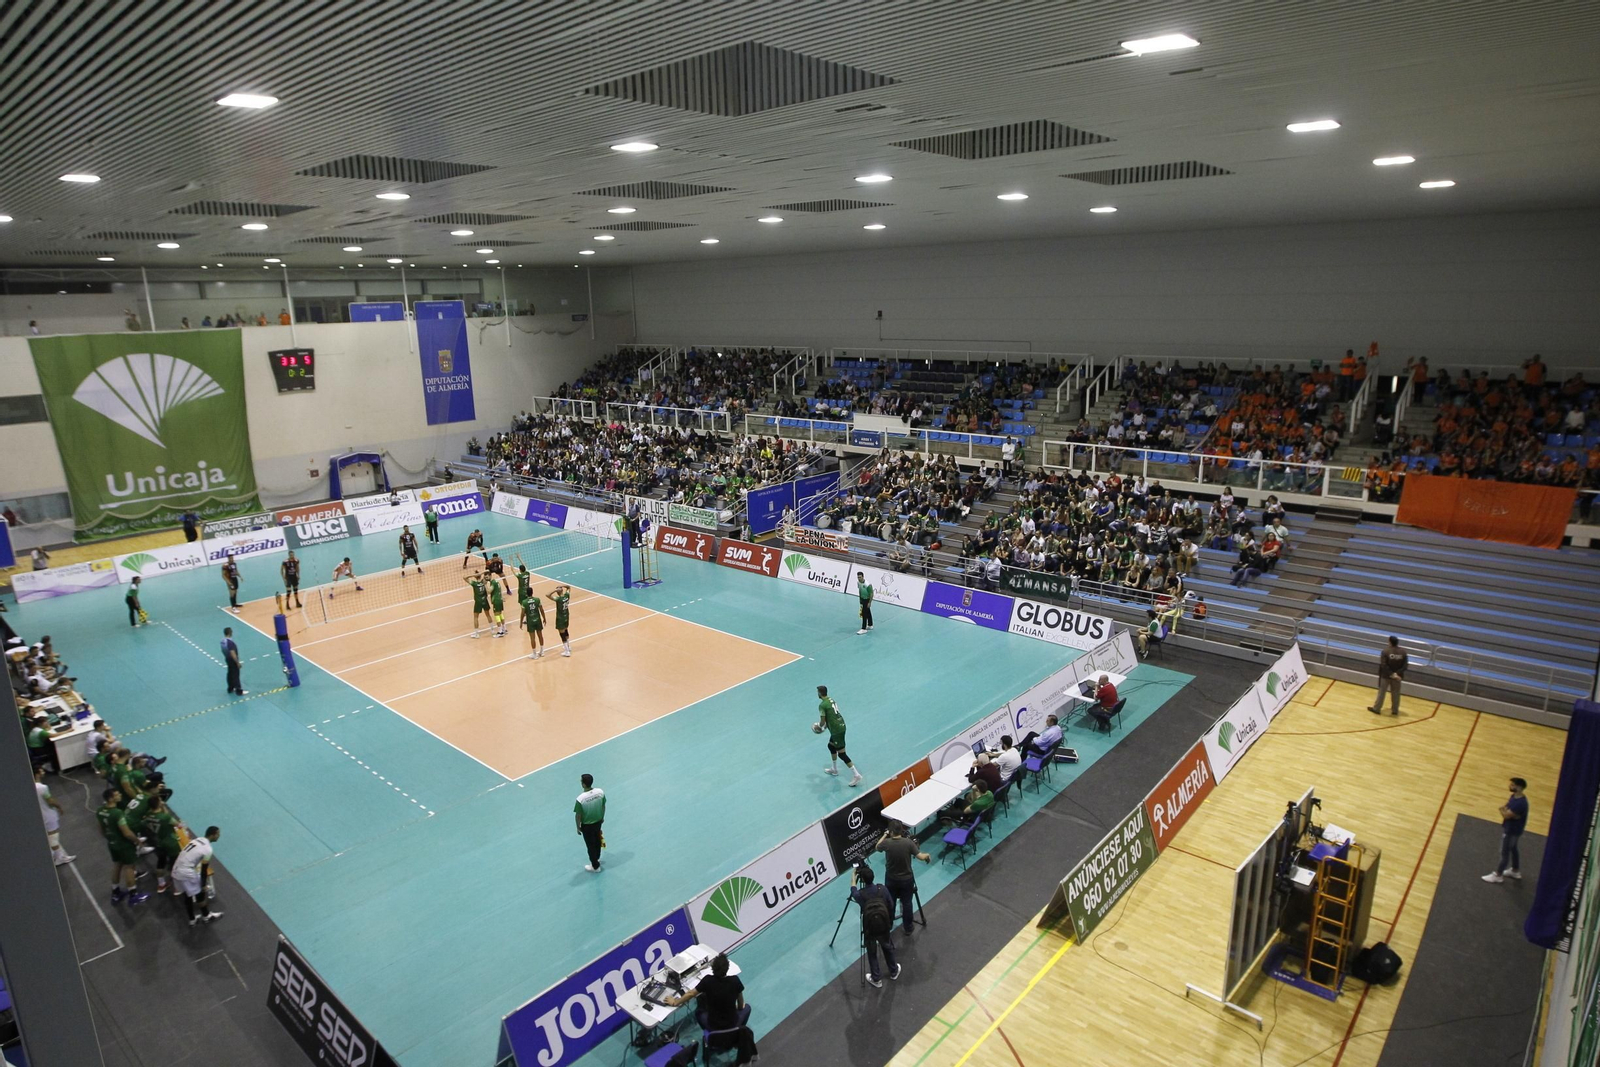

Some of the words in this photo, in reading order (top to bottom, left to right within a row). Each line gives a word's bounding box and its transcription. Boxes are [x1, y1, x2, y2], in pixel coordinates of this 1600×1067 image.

[425, 374, 469, 385] DIPUTACIÓN
[438, 382, 469, 392] ALMERÍA
[105, 460, 226, 497] Unicaja
[351, 498, 372, 508] Diario
[650, 500, 665, 516] LOS
[295, 507, 343, 524] ALMERÍA
[295, 517, 348, 540] URCI
[299, 532, 350, 547] HORMIGONES
[662, 533, 688, 548] SVM
[796, 536, 807, 544] LA
[157, 554, 202, 571] Unicaja
[725, 546, 752, 562] SVM
[808, 571, 841, 588] Unicaja
[935, 602, 965, 614] DIPUTACIÓN
[965, 608, 972, 616] DE
[973, 610, 994, 621] ALMERÍA
[1017, 602, 1105, 640] GLOBUS
[1012, 624, 1044, 638] ITALIAN
[1045, 631, 1099, 651] EXCELLENC
[1281, 668, 1299, 692] Unicaja
[1235, 715, 1258, 744] Unicaja
[1165, 759, 1209, 826] ALMERÍA
[1068, 833, 1122, 904] ANÚNCIESE
[1123, 807, 1144, 846] AQUÍ
[762, 857, 827, 909] Unicaja
[1083, 882, 1102, 915] 950
[1103, 867, 1117, 893] 62
[1117, 852, 1128, 878] 07
[1130, 839, 1142, 865] 30
